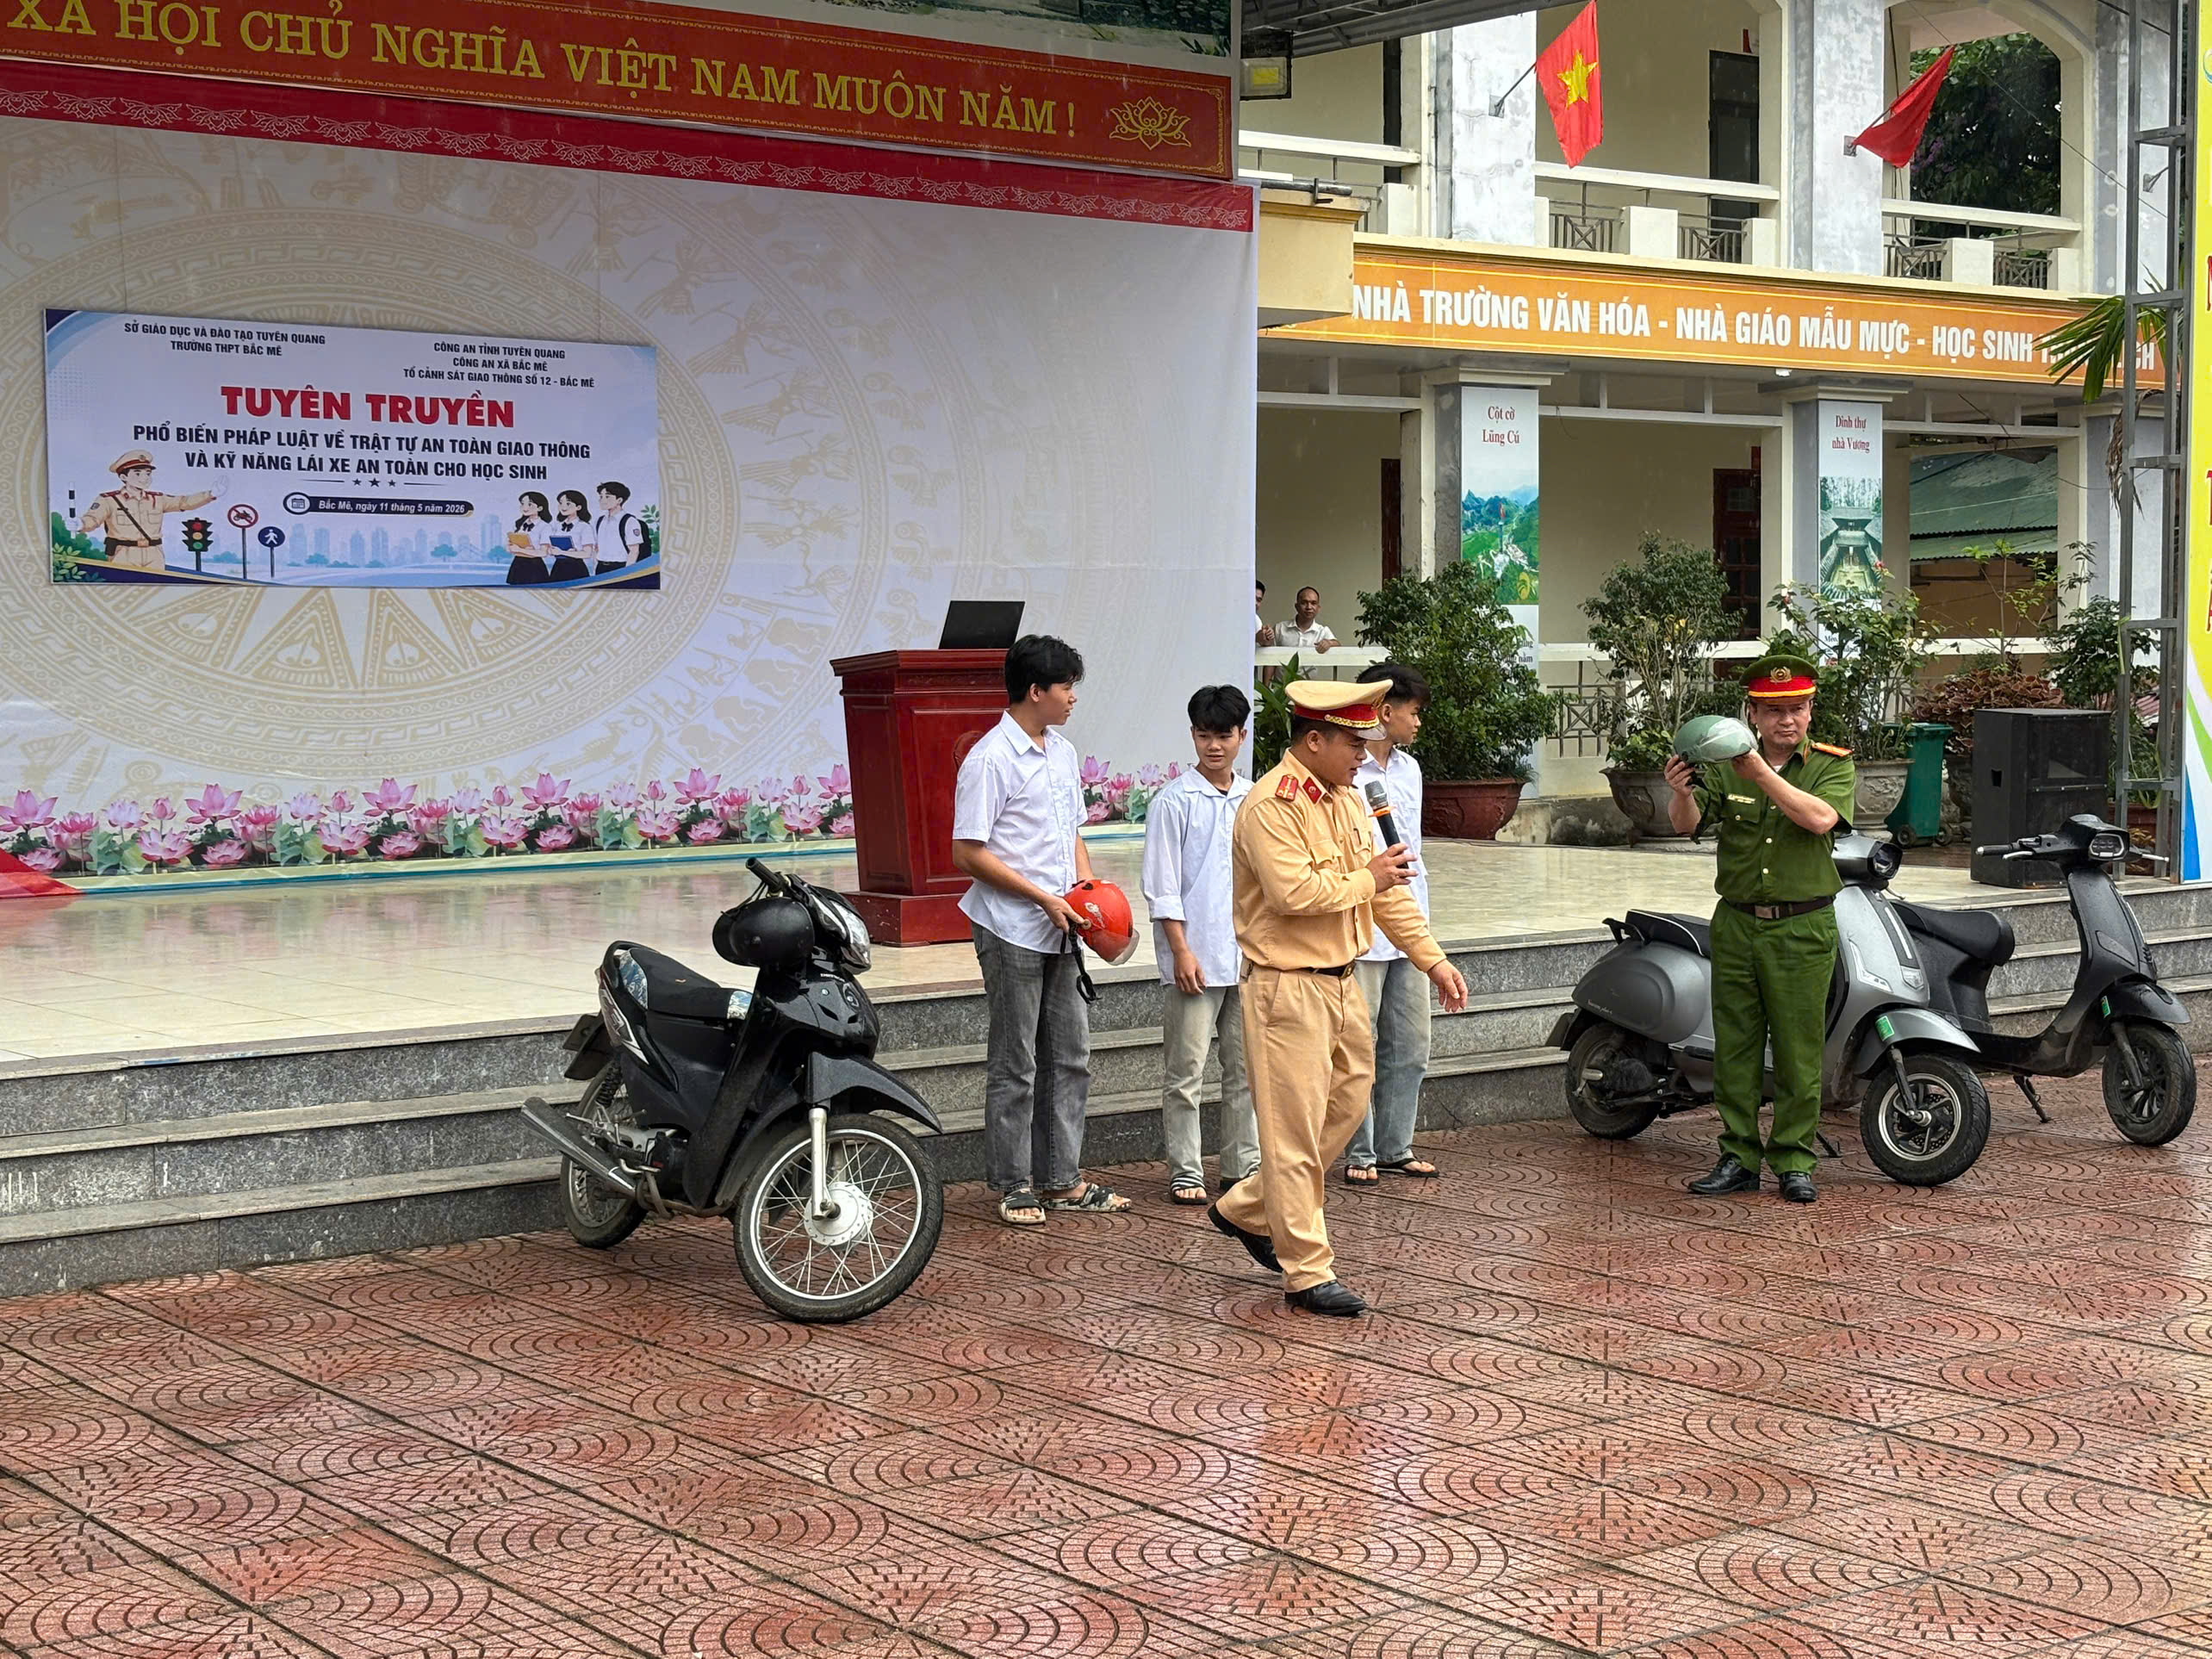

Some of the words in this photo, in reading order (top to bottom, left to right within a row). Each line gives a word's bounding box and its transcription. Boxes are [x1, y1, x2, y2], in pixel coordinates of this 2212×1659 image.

[239, 0, 352, 59] CHỦ
[370, 22, 545, 78] NGHĨA
[560, 37, 677, 98] VIỆT
[691, 58, 800, 105] NAM
[812, 70, 947, 122] MUÔN
[959, 84, 1057, 135] NĂM
[1068, 103, 1075, 137] !
[1353, 281, 1412, 323] NHÀ
[1419, 285, 1529, 330] TRƯỜNG
[1537, 291, 1591, 333] VĂN
[1599, 295, 1651, 337] HÓA
[1675, 303, 1728, 343] NHÀ
[1735, 307, 1792, 346] GIÁO
[1799, 306, 1852, 350] MẪU
[1859, 320, 1910, 359] MỰC
[1932, 326, 1975, 363] HỌC
[1982, 329, 2033, 363] SINH
[124, 320, 139, 332] SỞ
[142, 322, 167, 334] GIÁO
[170, 326, 190, 338] DỤC
[194, 326, 208, 338] VÀ
[210, 327, 231, 339] ĐÀO
[233, 329, 253, 342] TẠO
[256, 330, 289, 342] TUYÊN
[291, 333, 326, 345] QUANG
[171, 339, 213, 352] TRƯỜNG
[214, 343, 239, 354] THPT
[267, 345, 283, 356] MÊ
[434, 342, 460, 353] CÔNG
[463, 345, 475, 354] AN
[479, 343, 500, 355] TỈNH
[502, 345, 531, 357] TUYÊN
[534, 348, 565, 359] QUANG
[453, 357, 479, 367] CÔNG
[482, 359, 494, 369] AN
[497, 358, 510, 370] XÃ
[533, 361, 548, 371] MÊ
[419, 367, 444, 380] CẢNH
[447, 369, 464, 381] SÁT
[468, 372, 490, 382] GIAO
[492, 372, 522, 384] THÔNG
[525, 372, 537, 385] SỐ
[540, 376, 551, 386] 12
[581, 377, 594, 388] MÊ
[221, 384, 351, 420] TUYÊN
[365, 389, 514, 428] TRUYỀN
[1488, 406, 1503, 424] Cột
[1505, 406, 1516, 420] cờ
[1836, 415, 1853, 428] Dinh
[1855, 416, 1867, 432] thự
[134, 421, 171, 441] PHỔ
[176, 423, 218, 444] BIẾN
[224, 427, 270, 446] PHÁP
[276, 430, 319, 450] LUẬT
[324, 429, 345, 449] VỀ
[350, 433, 389, 453] TRẬT
[396, 436, 419, 455] TỰ
[421, 438, 444, 453] AN
[450, 437, 492, 455] TOÀN
[497, 441, 534, 457] GIAO
[538, 441, 591, 458] THÔNG
[1482, 429, 1505, 446] Lũng
[1507, 430, 1519, 444] Cú
[1832, 436, 1845, 449] nhà
[185, 452, 208, 468] VÀ
[214, 451, 236, 469] KỸ
[242, 452, 291, 471] NĂNG
[297, 454, 323, 472] LÁI
[329, 457, 351, 473] XE
[356, 459, 380, 474] AN
[385, 457, 428, 475] TOÀN
[433, 462, 466, 477] CHO
[471, 463, 504, 481] HỌC
[509, 465, 547, 480] SINH
[319, 499, 336, 510] Bắc
[356, 502, 376, 513] ngày
[390, 504, 415, 514] tháng
[425, 504, 443, 513] năm
[444, 505, 465, 513] 2026
